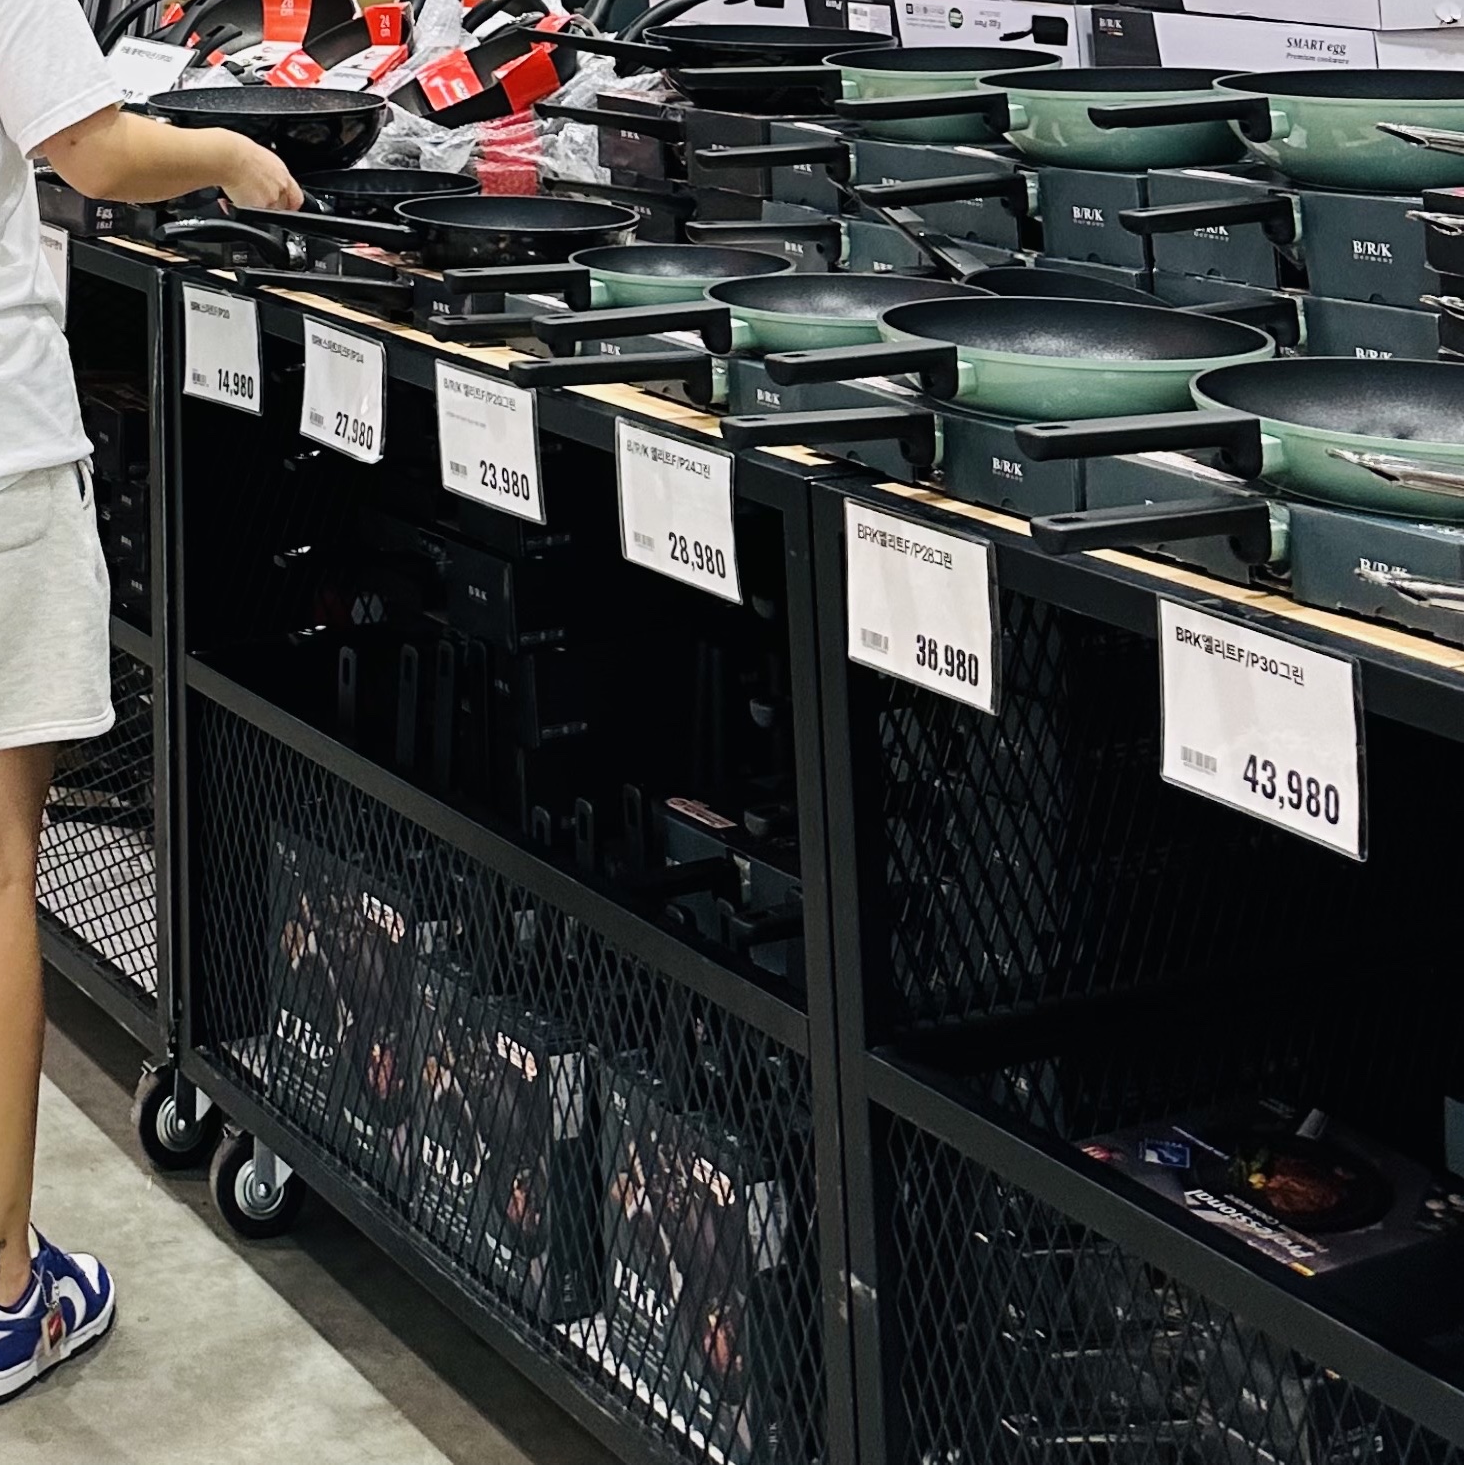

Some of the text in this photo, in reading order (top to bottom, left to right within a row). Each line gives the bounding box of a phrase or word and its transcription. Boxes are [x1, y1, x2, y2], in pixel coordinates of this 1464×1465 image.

[380, 15, 390, 27] 24
[1287, 37, 1347, 56] SMART egg
[1072, 206, 1104, 222] B/R/K
[1352, 240, 1392, 259] B/R/K
[218, 369, 254, 399] 14,980
[334, 412, 373, 450] 27,980
[480, 460, 530, 501] 23,980
[992, 456, 1024, 477] B/R/K
[669, 532, 726, 579] 28,980
[1175, 626, 1304, 686] BRK엘리트F/P30그린
[1243, 754, 1340, 825] 43,980
[1185, 1189, 1315, 1258] Professional
